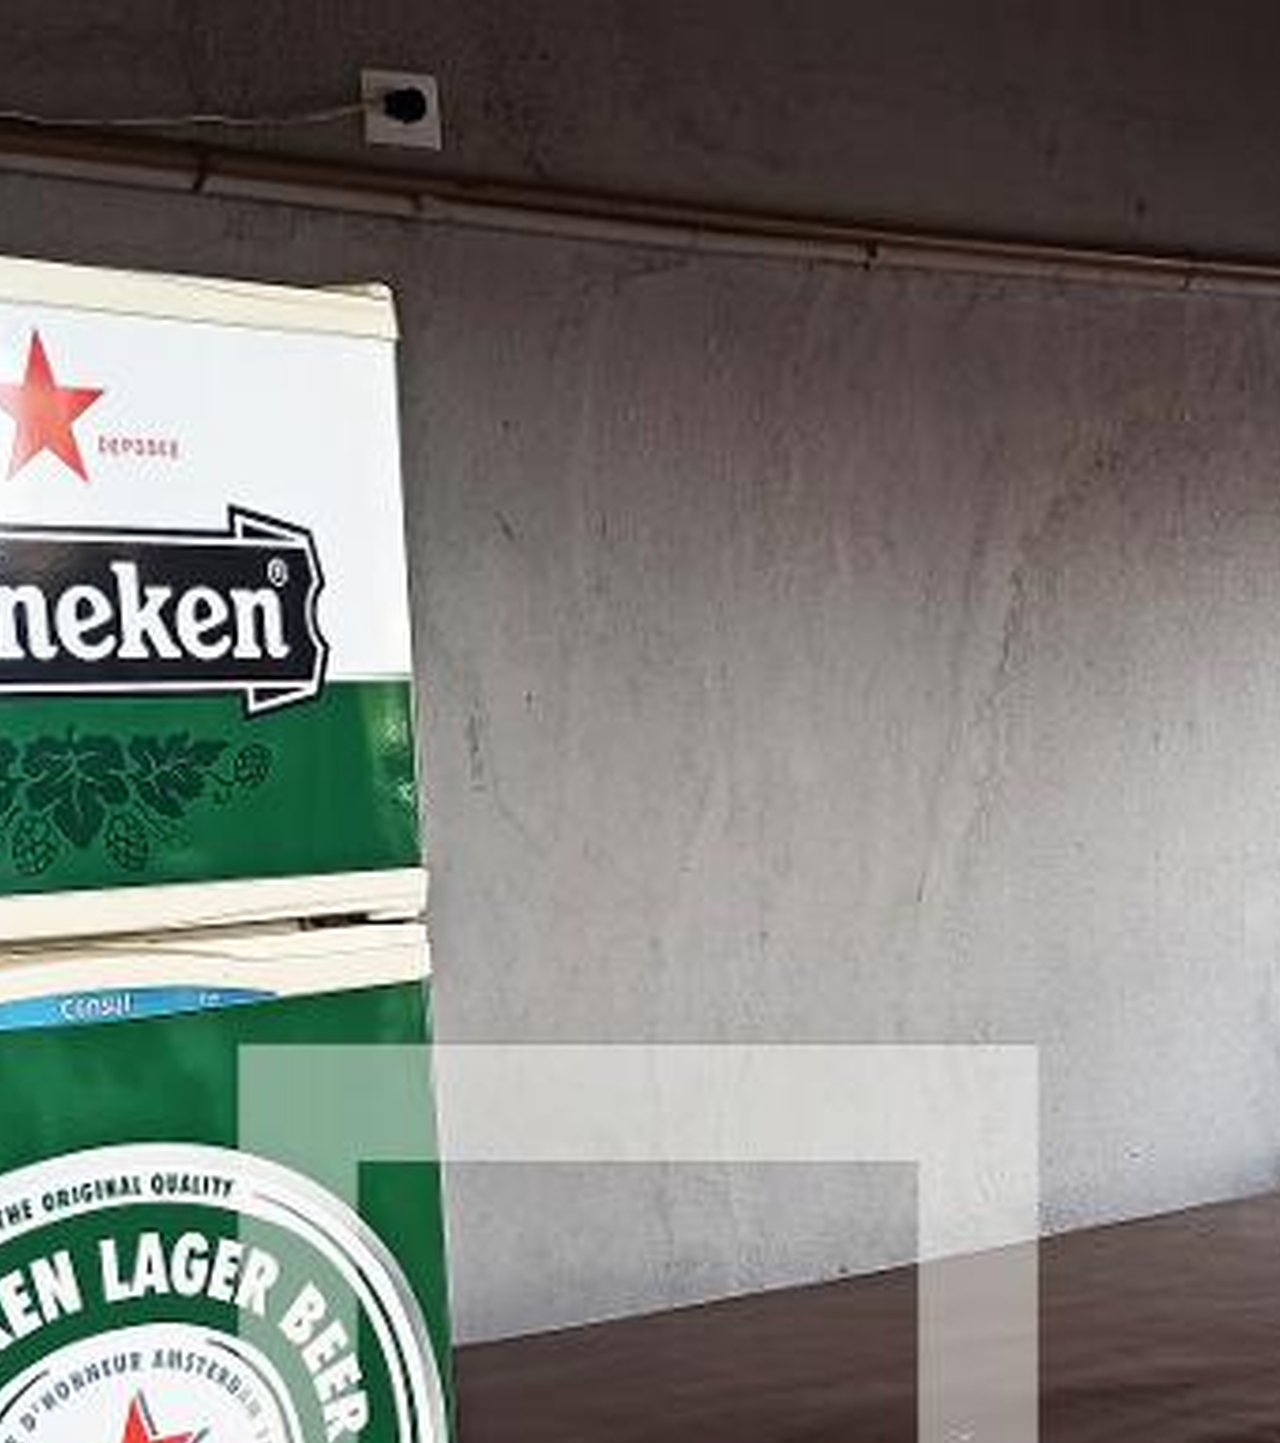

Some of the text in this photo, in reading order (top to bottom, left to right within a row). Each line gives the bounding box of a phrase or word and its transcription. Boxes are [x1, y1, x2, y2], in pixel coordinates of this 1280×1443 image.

[41, 1175, 142, 1212] ORIGINAL
[150, 1172, 235, 1199] QUALITY
[99, 1231, 280, 1317] LAGER
[278, 1282, 371, 1443] BEER
